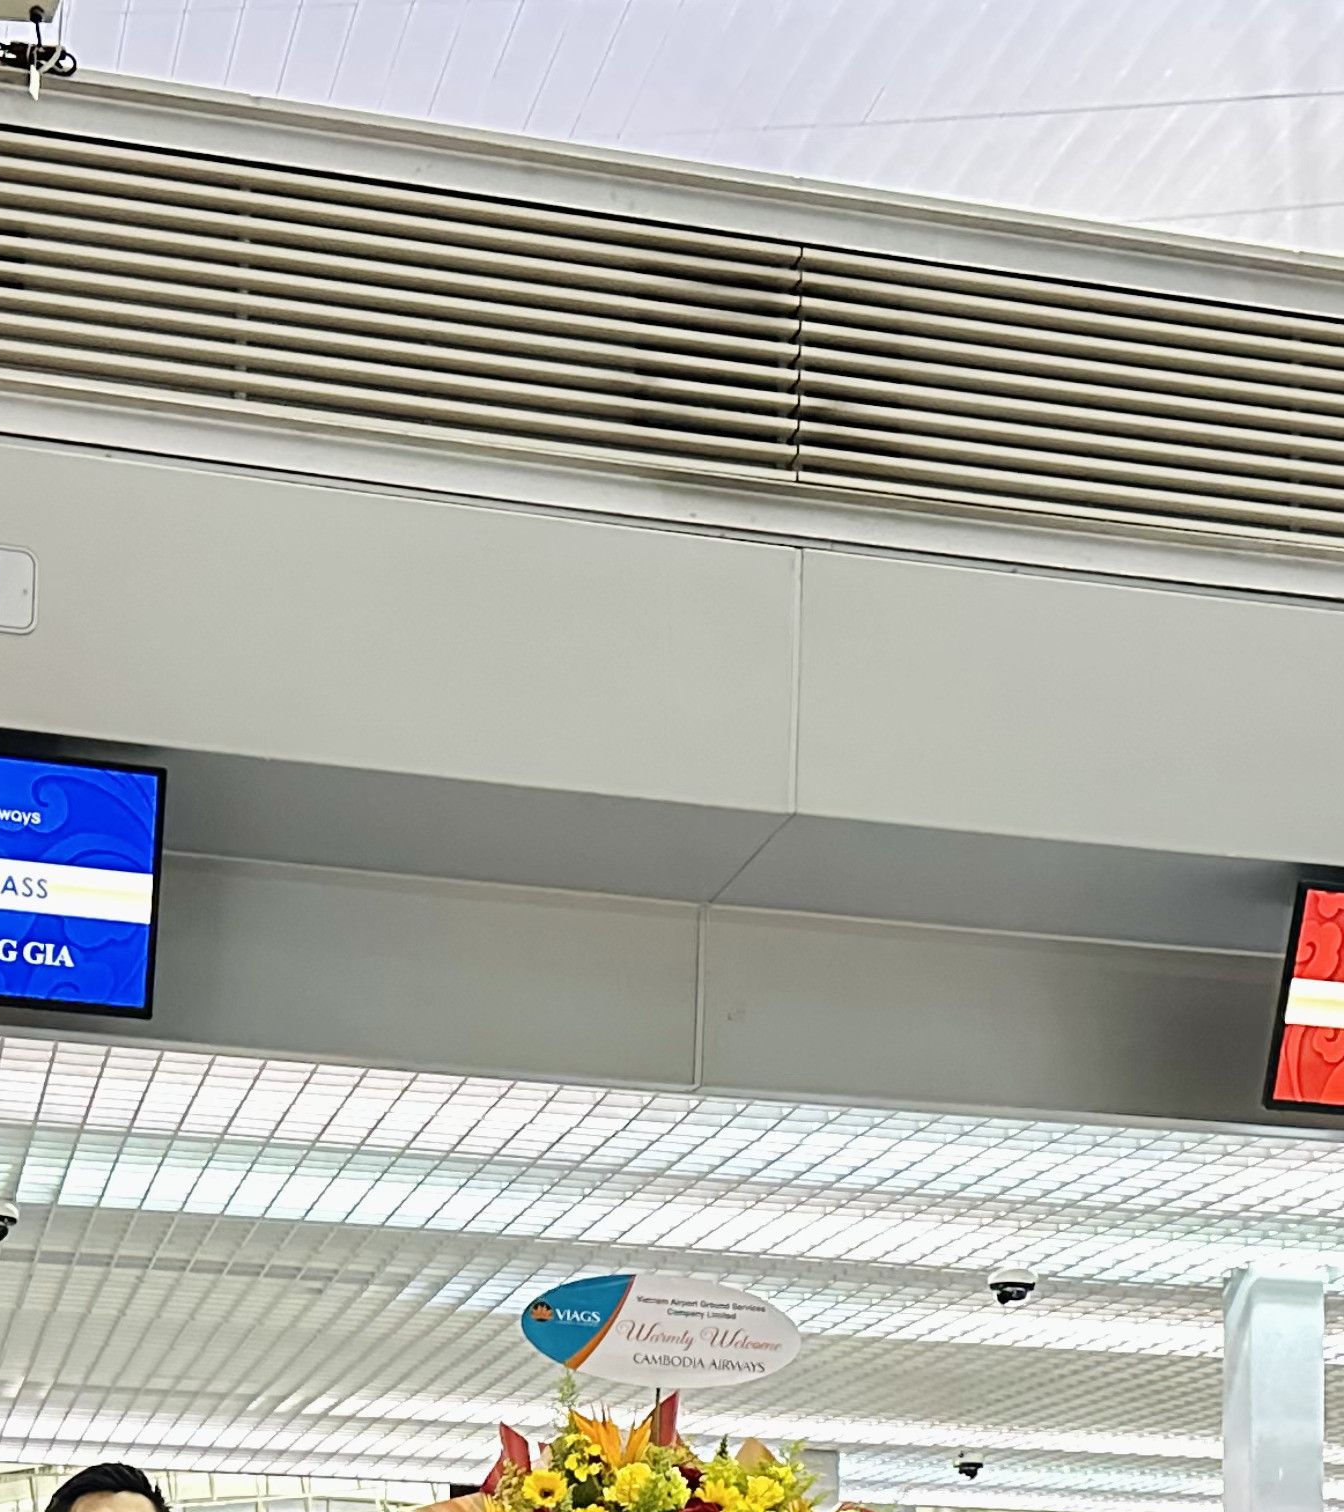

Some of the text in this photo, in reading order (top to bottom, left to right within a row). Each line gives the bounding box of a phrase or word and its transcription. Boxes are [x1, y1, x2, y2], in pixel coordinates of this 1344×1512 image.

[22, 941, 75, 967] GIA
[555, 1308, 601, 1323] VIAGS
[615, 1319, 783, 1352] Warmly Welcome
[633, 1352, 766, 1373] CAMBODIA AIRWAYS
